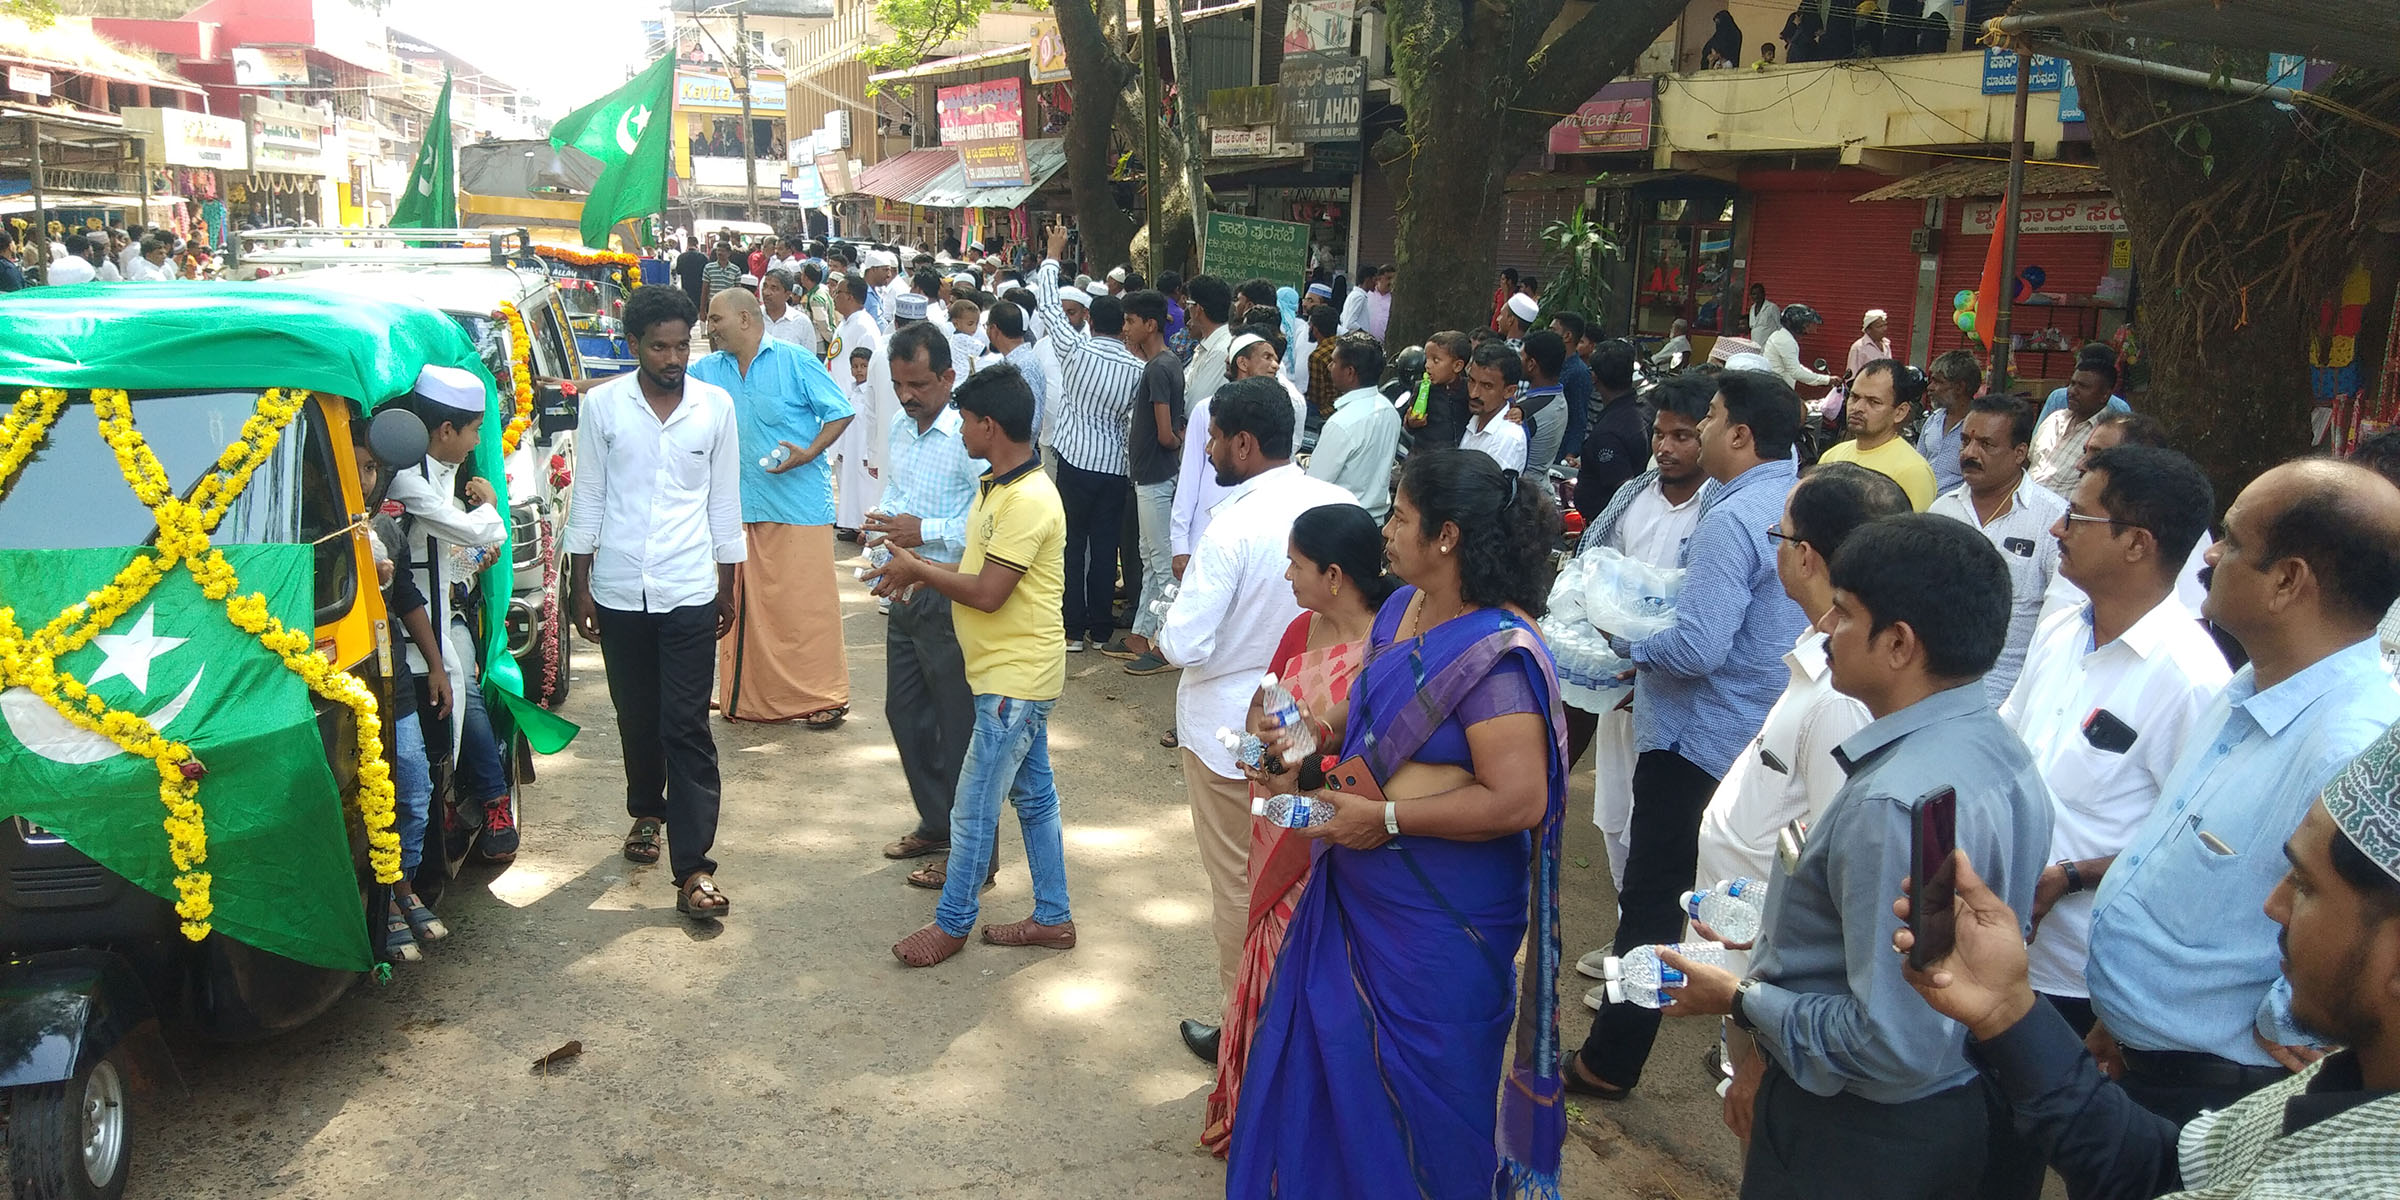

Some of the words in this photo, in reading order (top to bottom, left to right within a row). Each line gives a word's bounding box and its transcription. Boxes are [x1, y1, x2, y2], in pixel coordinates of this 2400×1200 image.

[682, 82, 731, 102] Kavita
[1323, 97, 1360, 124] AHAD
[994, 121, 1019, 138] SWEETS
